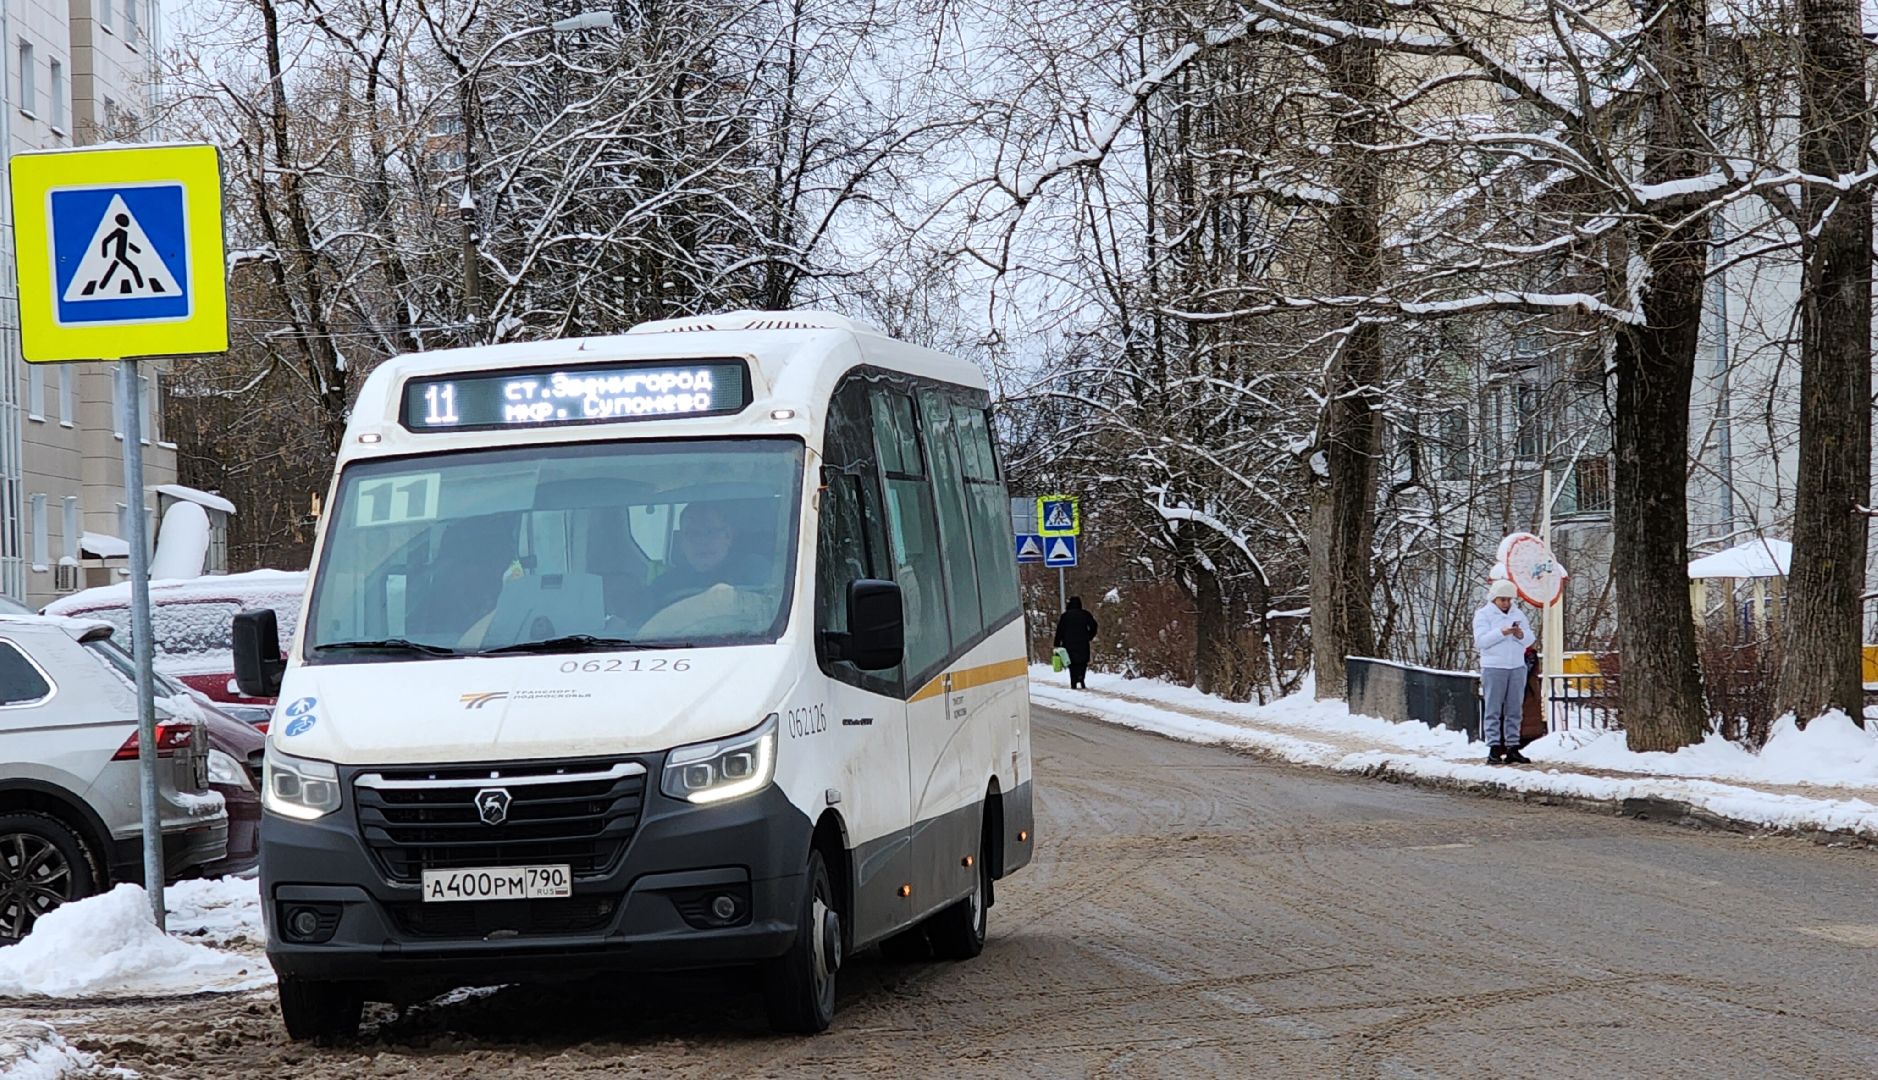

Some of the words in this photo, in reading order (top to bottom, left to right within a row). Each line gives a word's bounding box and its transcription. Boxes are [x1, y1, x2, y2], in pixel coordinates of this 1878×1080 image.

[425, 384, 458, 424] 11
[361, 479, 428, 522] 11
[559, 658, 691, 673] 062126
[788, 703, 827, 739] 062126
[527, 868, 563, 888] 790
[536, 888, 555, 896] RUS
